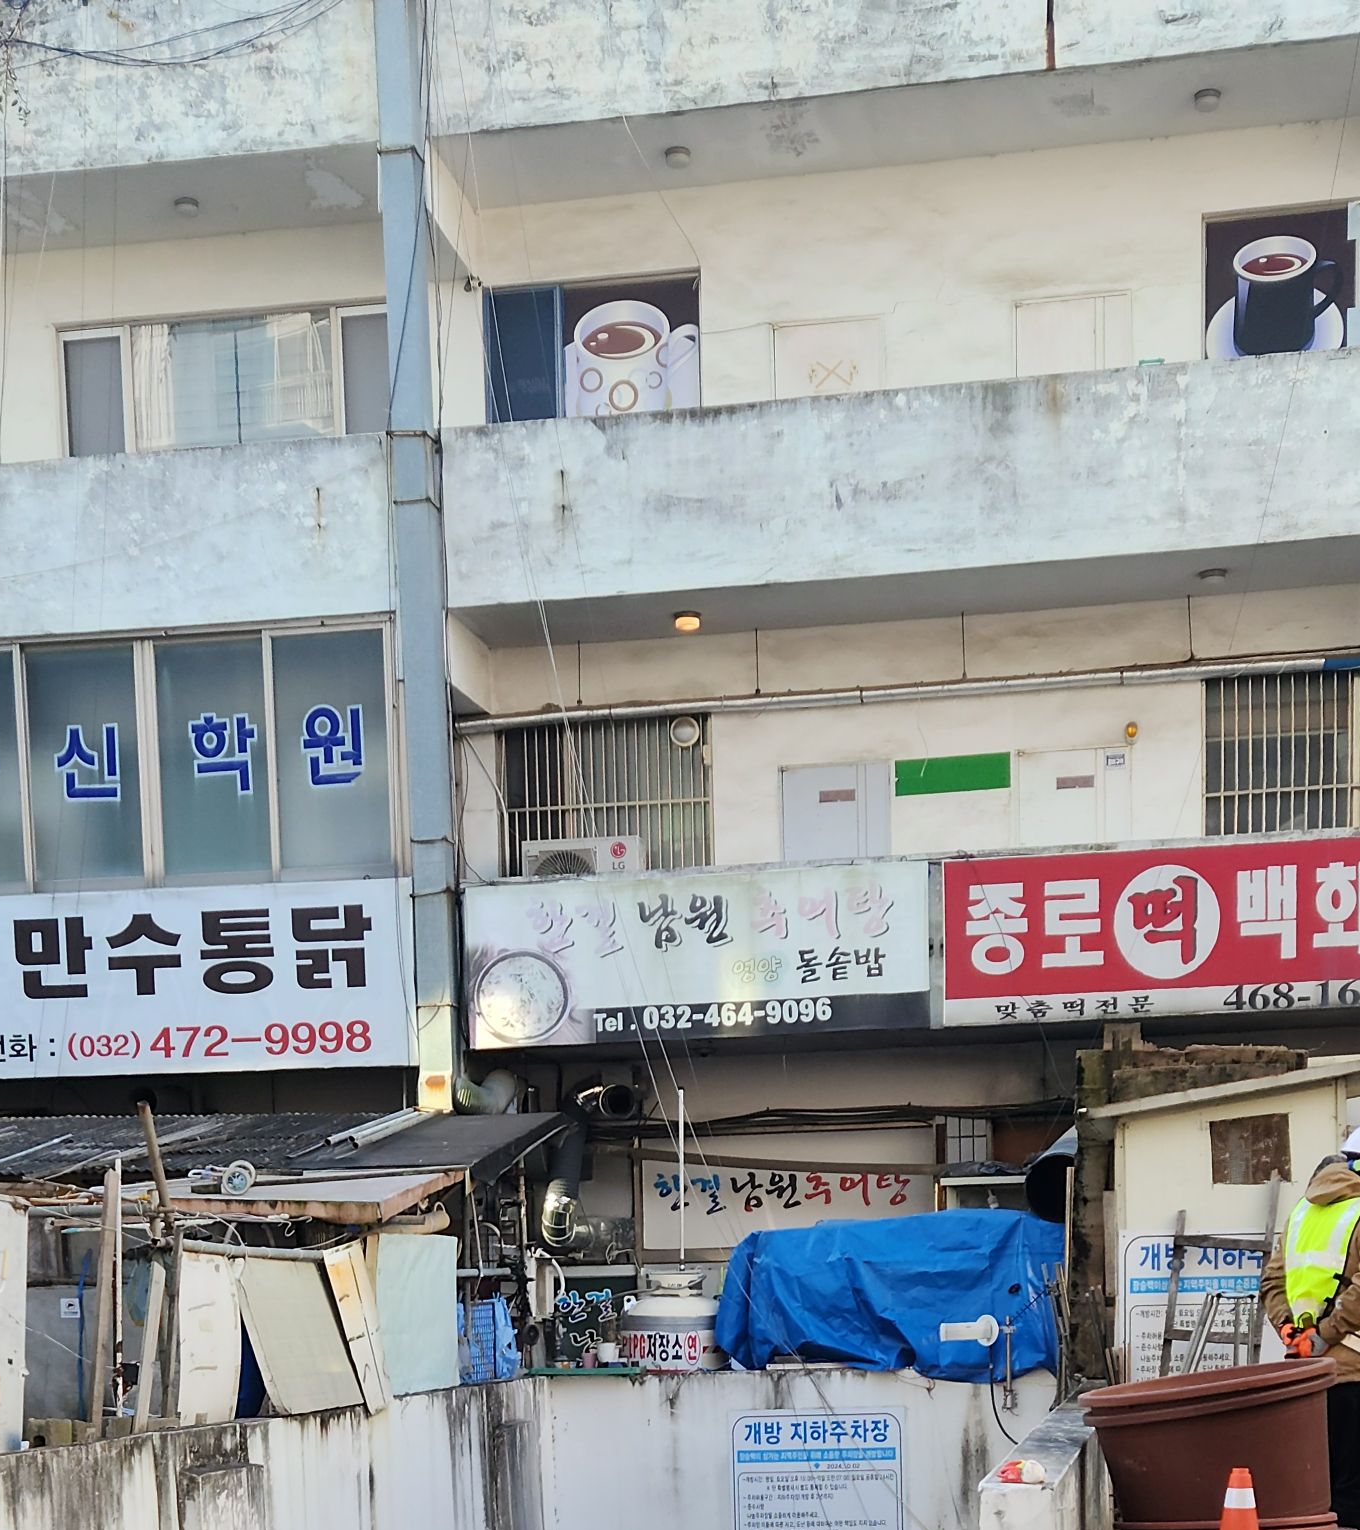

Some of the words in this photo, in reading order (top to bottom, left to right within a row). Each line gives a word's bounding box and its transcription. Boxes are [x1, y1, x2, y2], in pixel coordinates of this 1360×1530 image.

[613, 861, 625, 870] LG
[14, 904, 372, 999] 만수통닭
[796, 947, 886, 984] 돌솥밥
[642, 997, 832, 1030] 032-464-9096
[67, 1029, 140, 1061] (032)
[149, 1019, 372, 1060] 472-9998
[744, 1421, 782, 1446] 개방
[790, 1419, 890, 1444] 지하주차장
